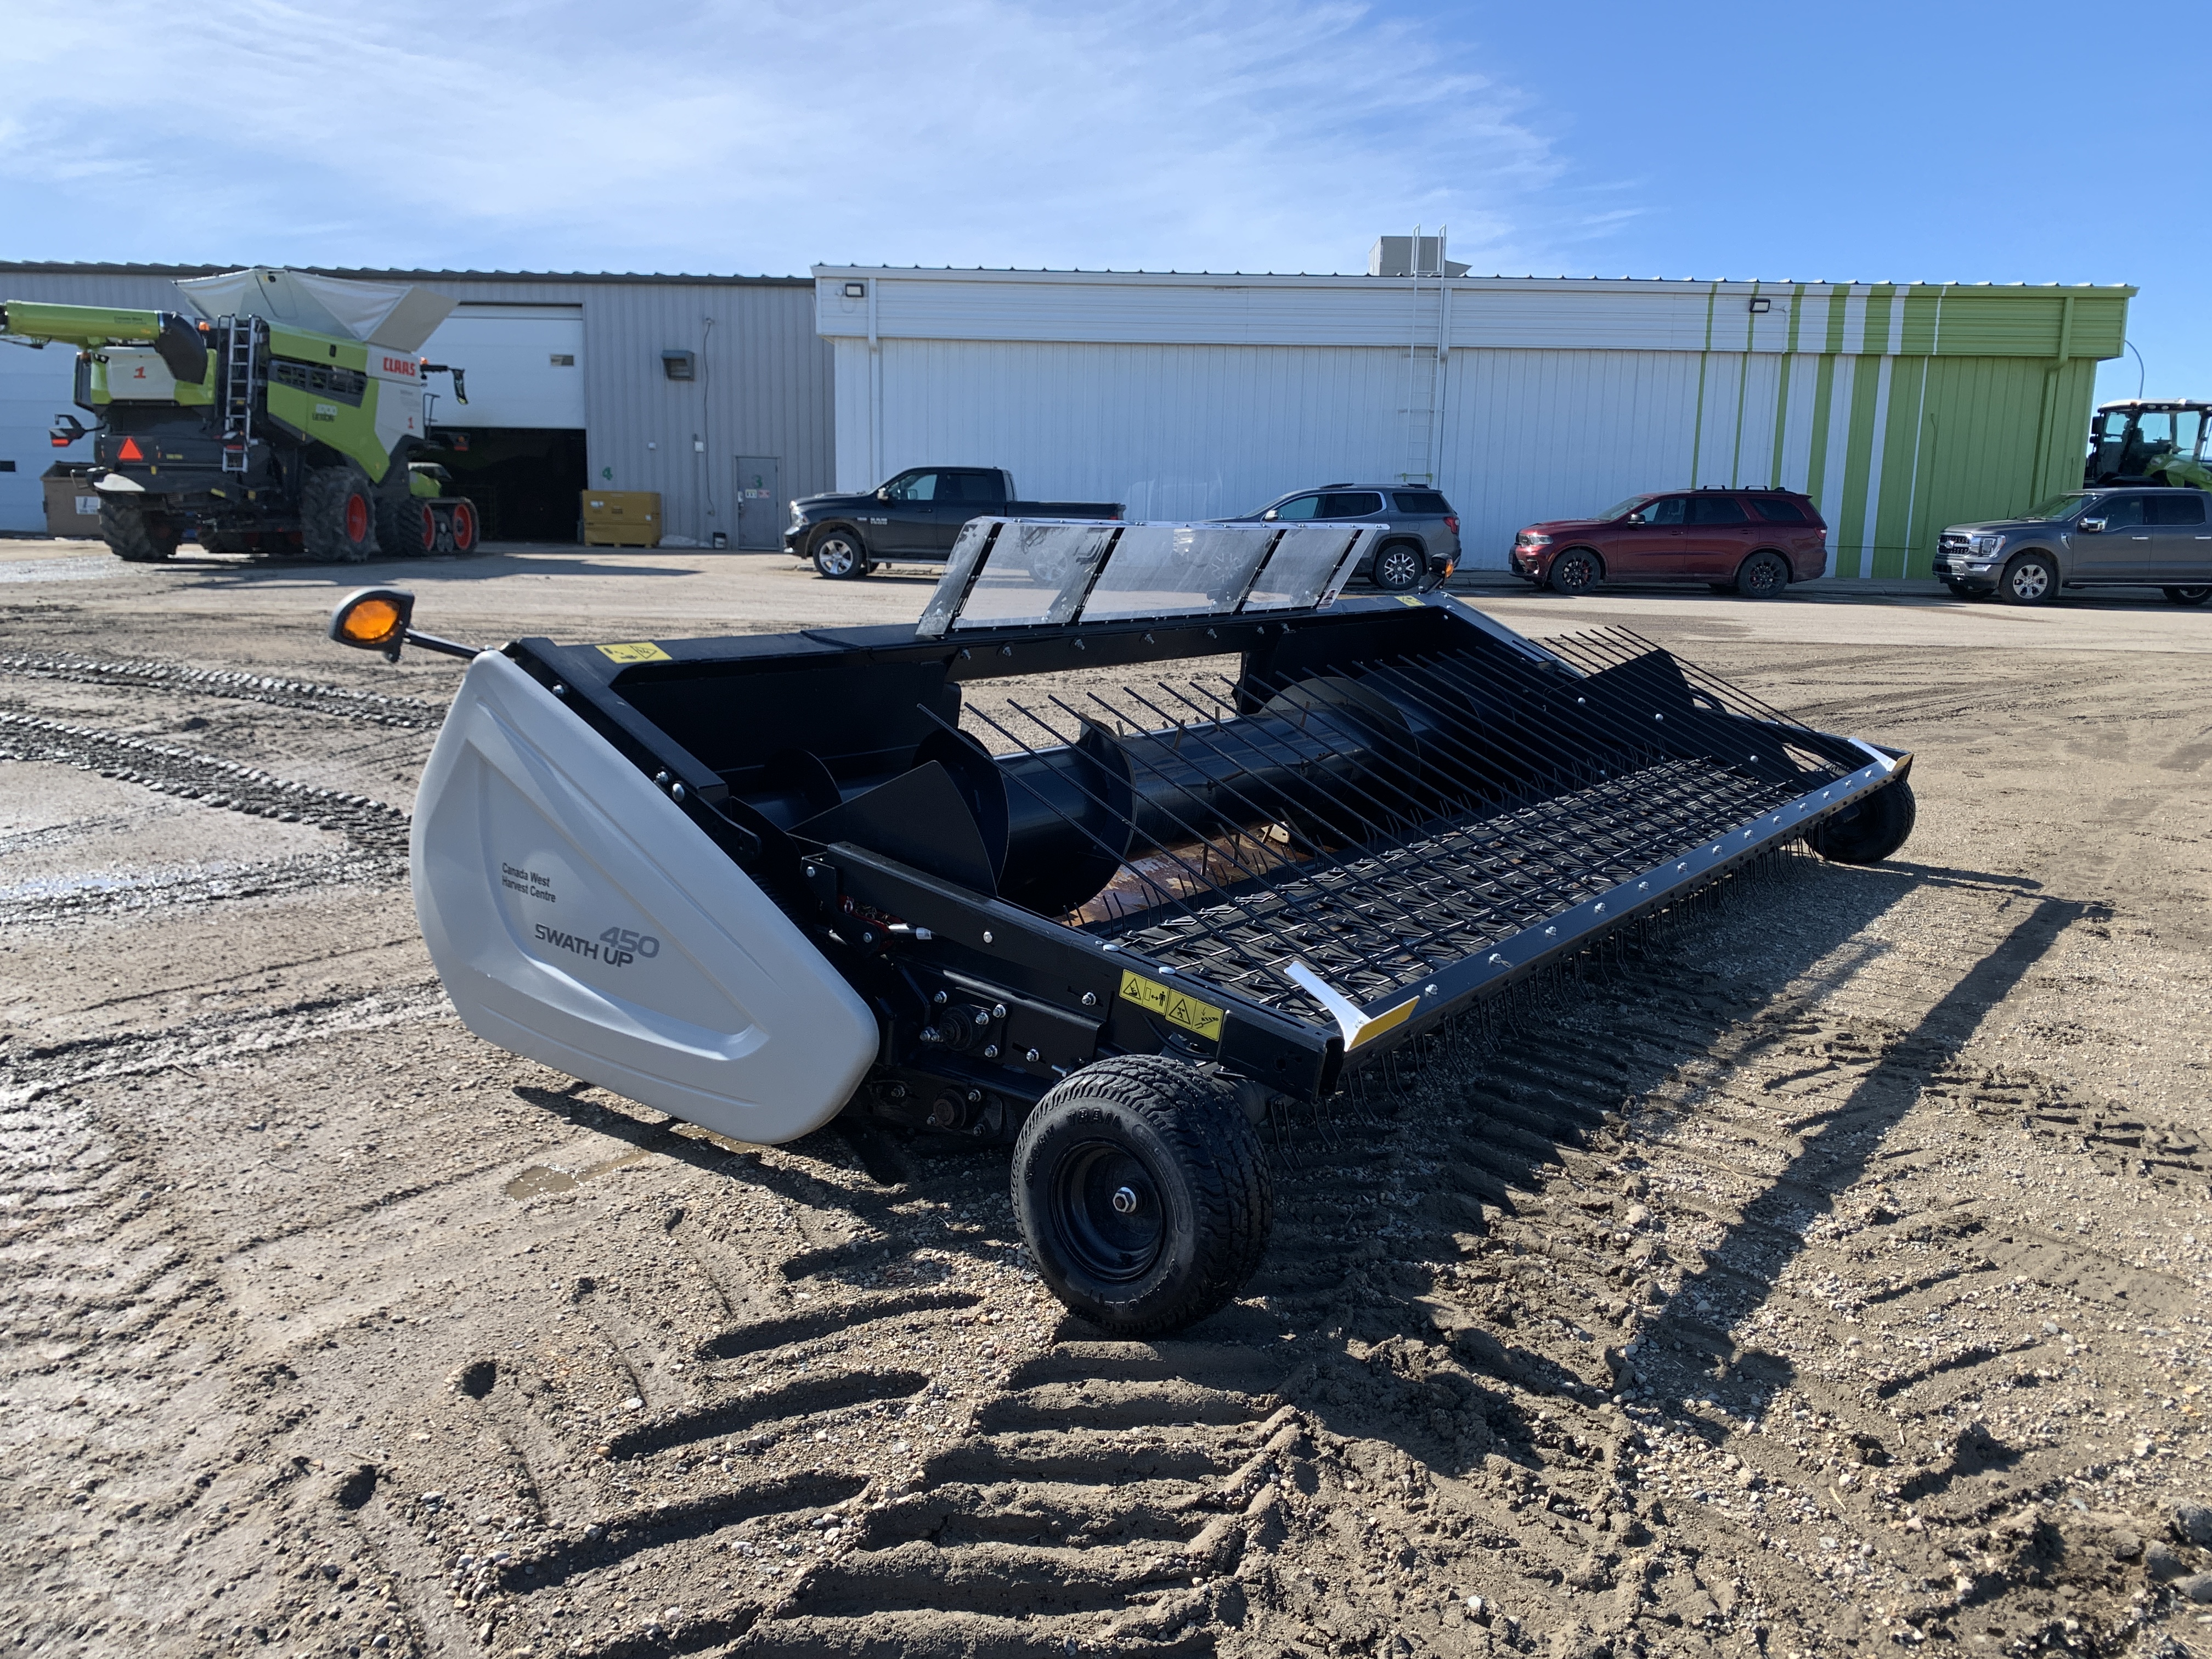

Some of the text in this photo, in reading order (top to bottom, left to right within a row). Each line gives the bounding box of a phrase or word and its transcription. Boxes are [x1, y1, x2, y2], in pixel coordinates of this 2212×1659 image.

[133, 366, 146, 379] 1
[383, 357, 415, 377] CLAAS
[502, 862, 550, 888] Canada West
[502, 875, 556, 903] Harvest Centre
[534, 923, 633, 967] SWATH UP
[600, 927, 659, 958] 450
[1066, 1108, 1122, 1130] TRAIL
